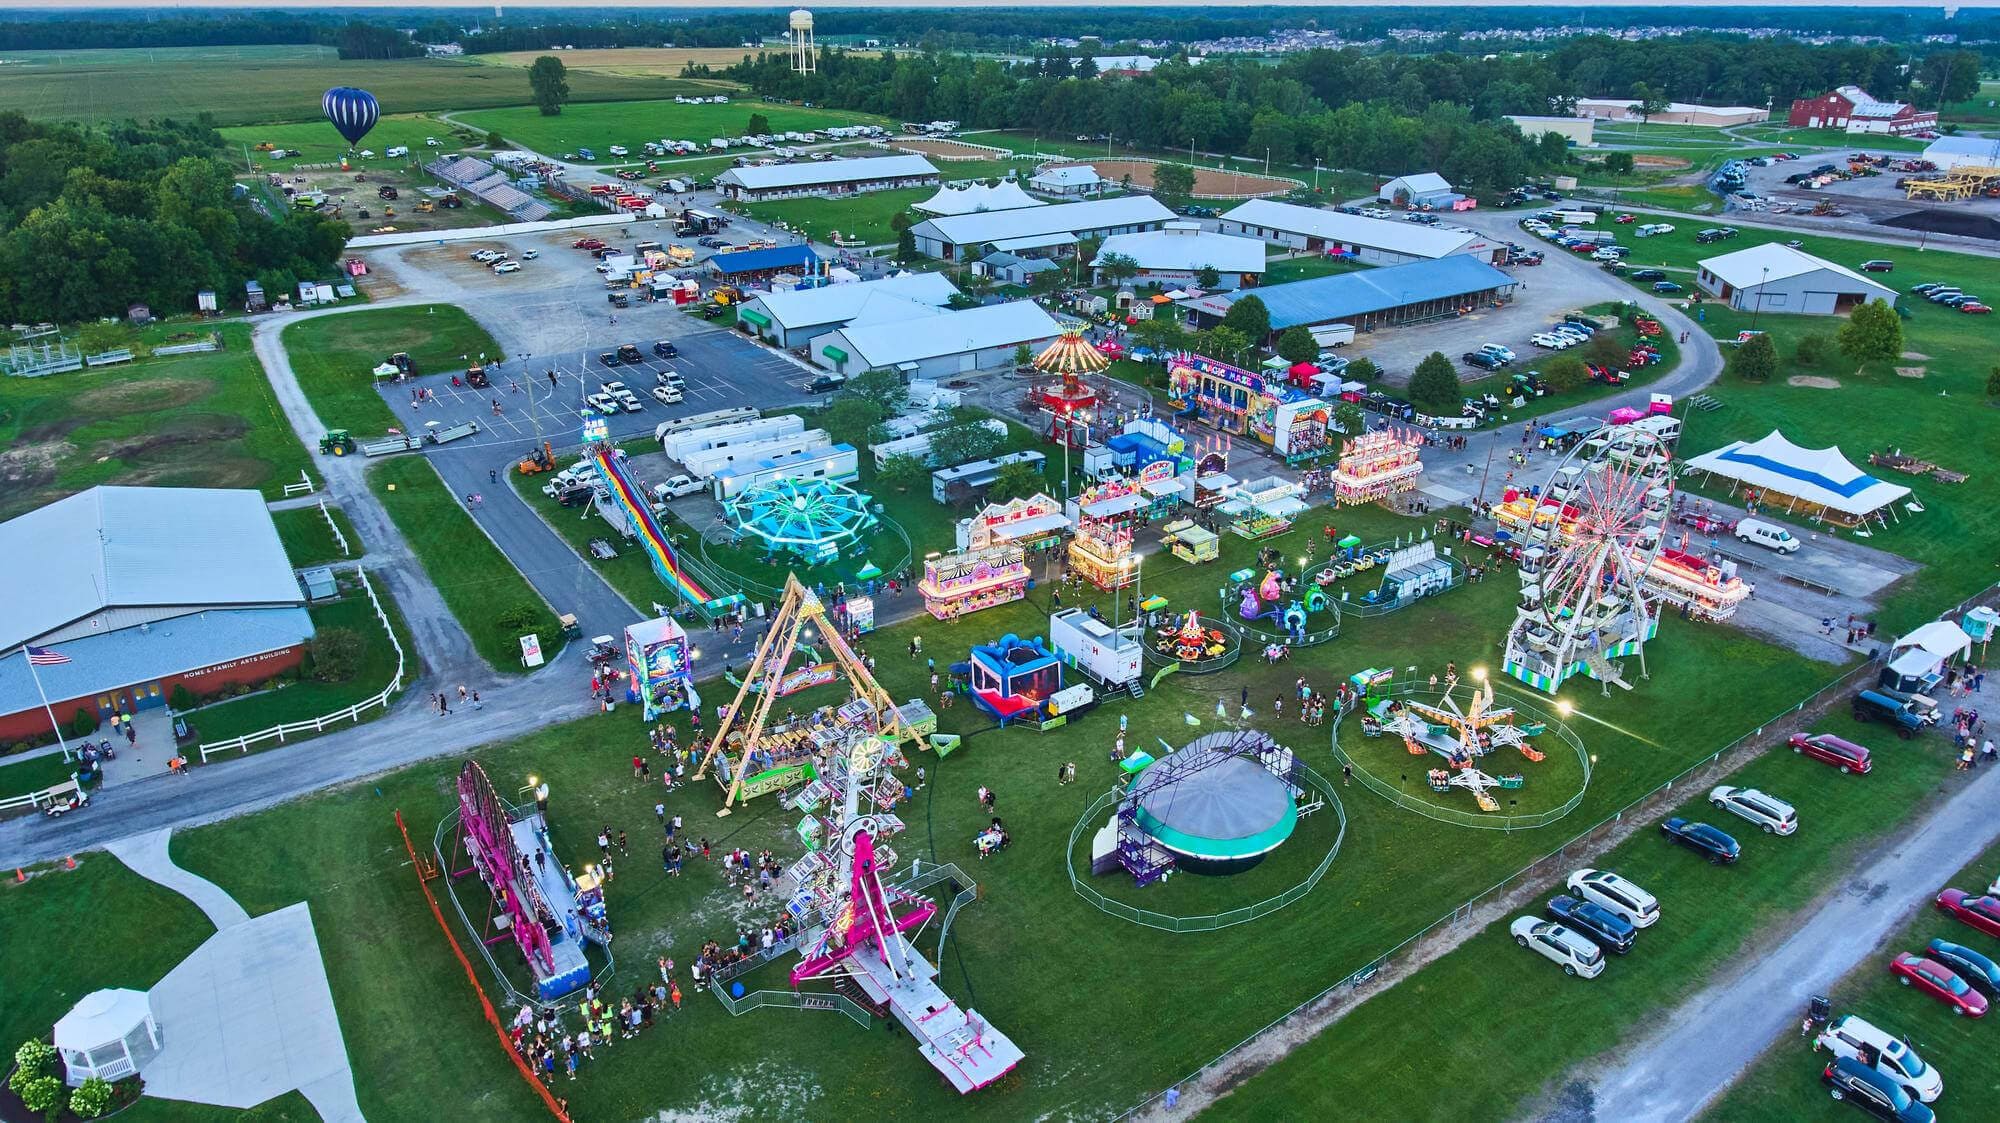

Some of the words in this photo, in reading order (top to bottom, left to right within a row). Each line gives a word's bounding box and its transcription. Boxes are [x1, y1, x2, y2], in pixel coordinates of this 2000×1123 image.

[1201, 362, 1225, 378] MAGIC
[1229, 371, 1252, 387] MAZE
[1145, 462, 1170, 473] LUCKY
[184, 669, 205, 679] HOME
[213, 663, 237, 672] FAMILY
[240, 656, 258, 666] ARTS
[260, 649, 291, 661] BUILDING
[1130, 661, 1137, 670] H
